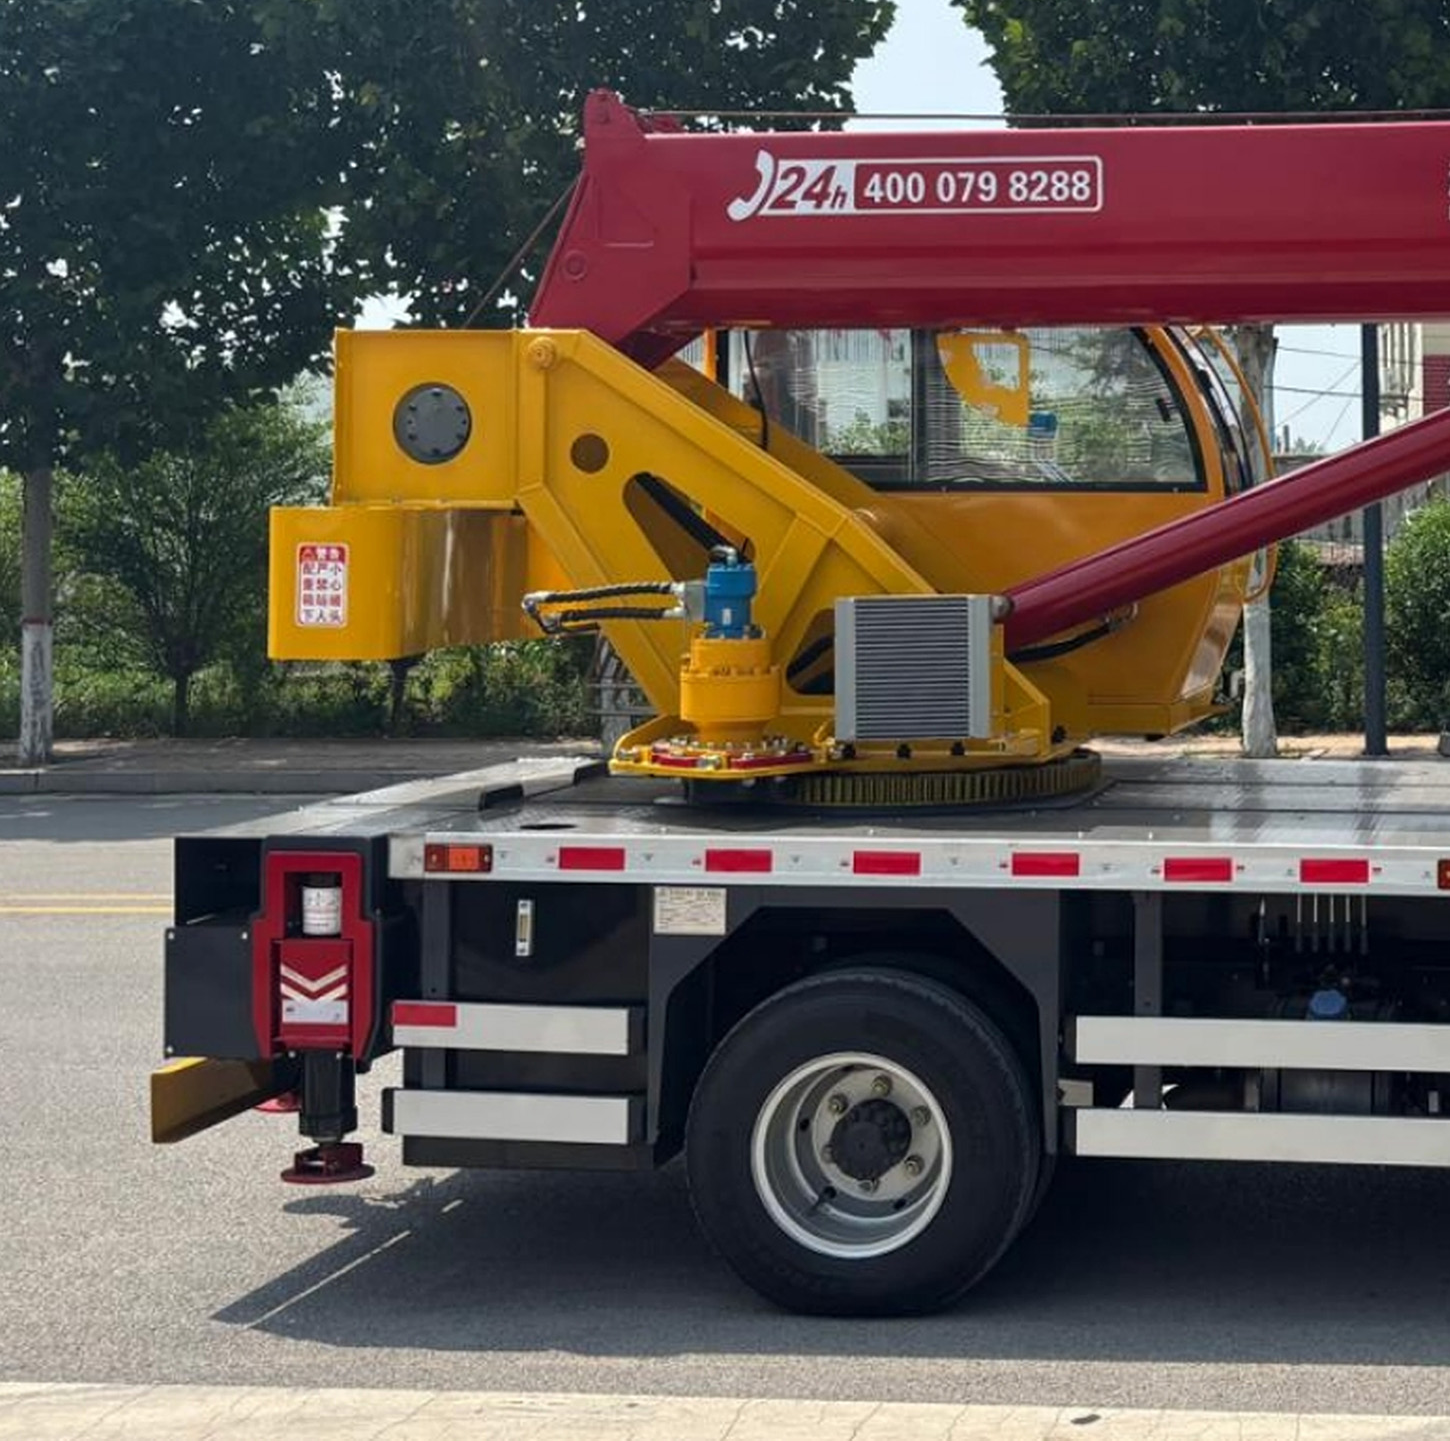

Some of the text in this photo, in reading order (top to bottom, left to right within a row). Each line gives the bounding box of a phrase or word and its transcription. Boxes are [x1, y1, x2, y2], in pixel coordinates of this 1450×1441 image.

[863, 170, 1091, 203] 400 079 8288
